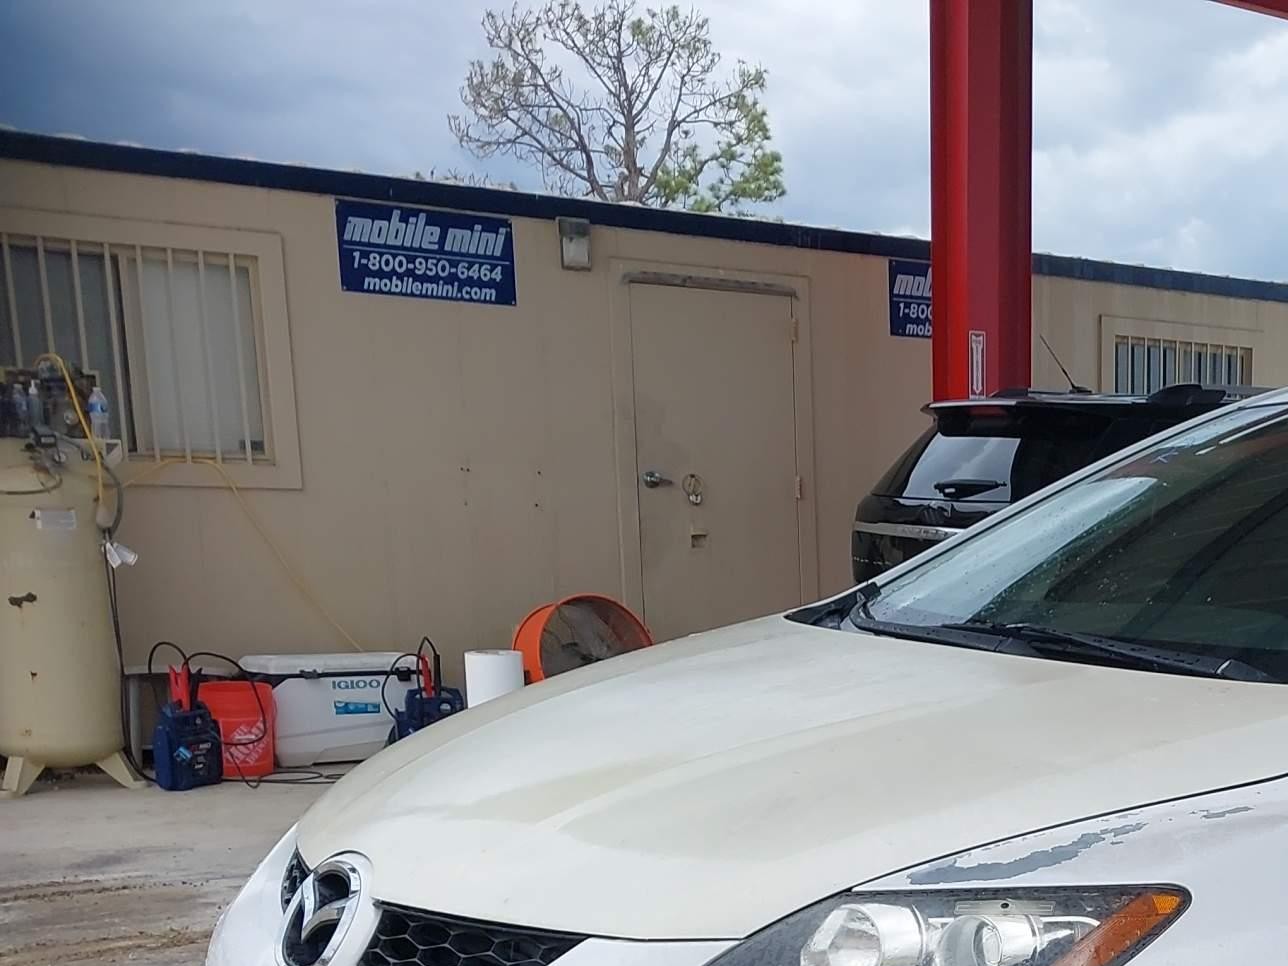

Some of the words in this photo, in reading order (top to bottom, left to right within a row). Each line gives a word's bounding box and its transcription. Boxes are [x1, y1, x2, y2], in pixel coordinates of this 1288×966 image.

[343, 209, 441, 250] mobile
[444, 224, 507, 257] mini
[352, 251, 503, 282] 1-800-950-6464
[363, 276, 496, 301] mobilemini.com
[331, 679, 381, 690] IGLOO
